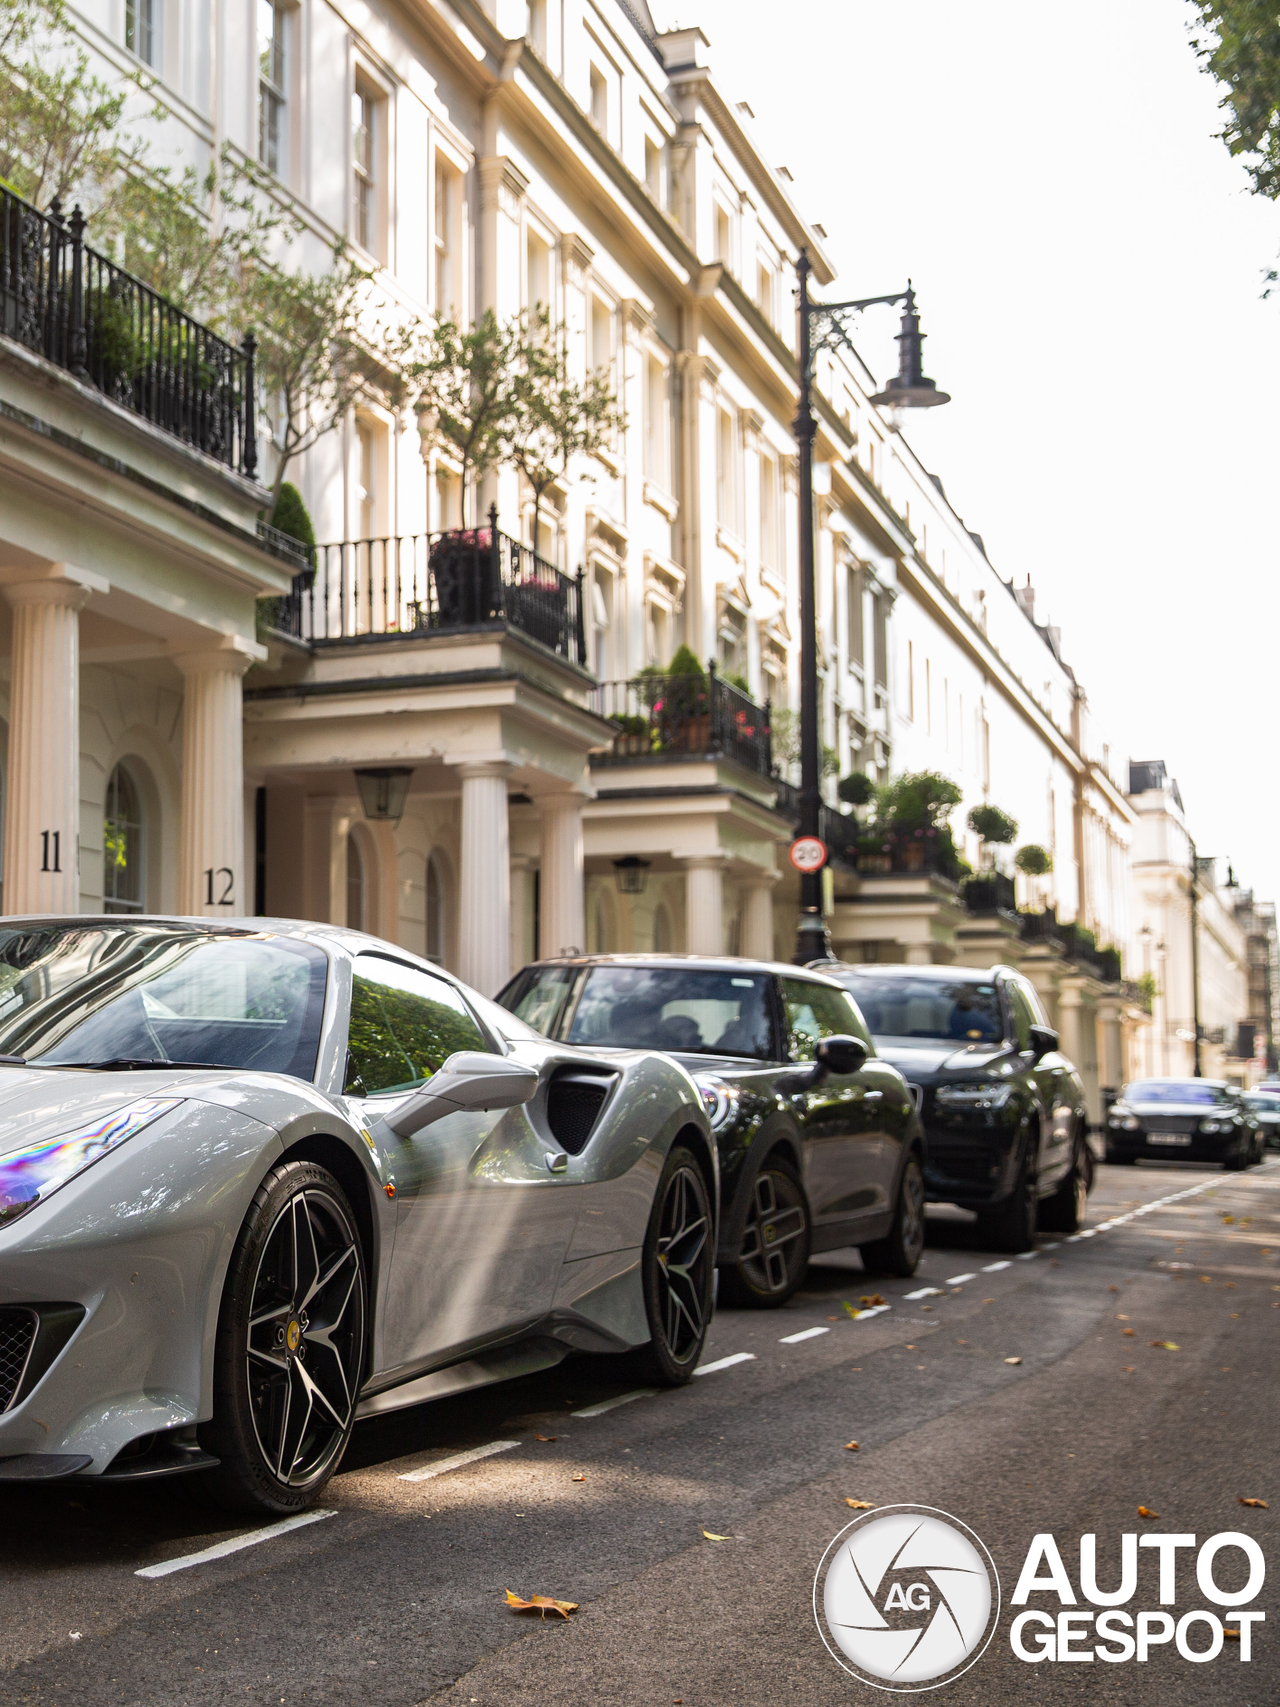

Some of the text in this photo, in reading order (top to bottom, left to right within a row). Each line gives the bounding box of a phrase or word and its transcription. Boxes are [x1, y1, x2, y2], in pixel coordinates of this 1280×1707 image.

[40, 829, 63, 872] 11
[798, 846, 820, 861] 20
[203, 867, 235, 906] 12
